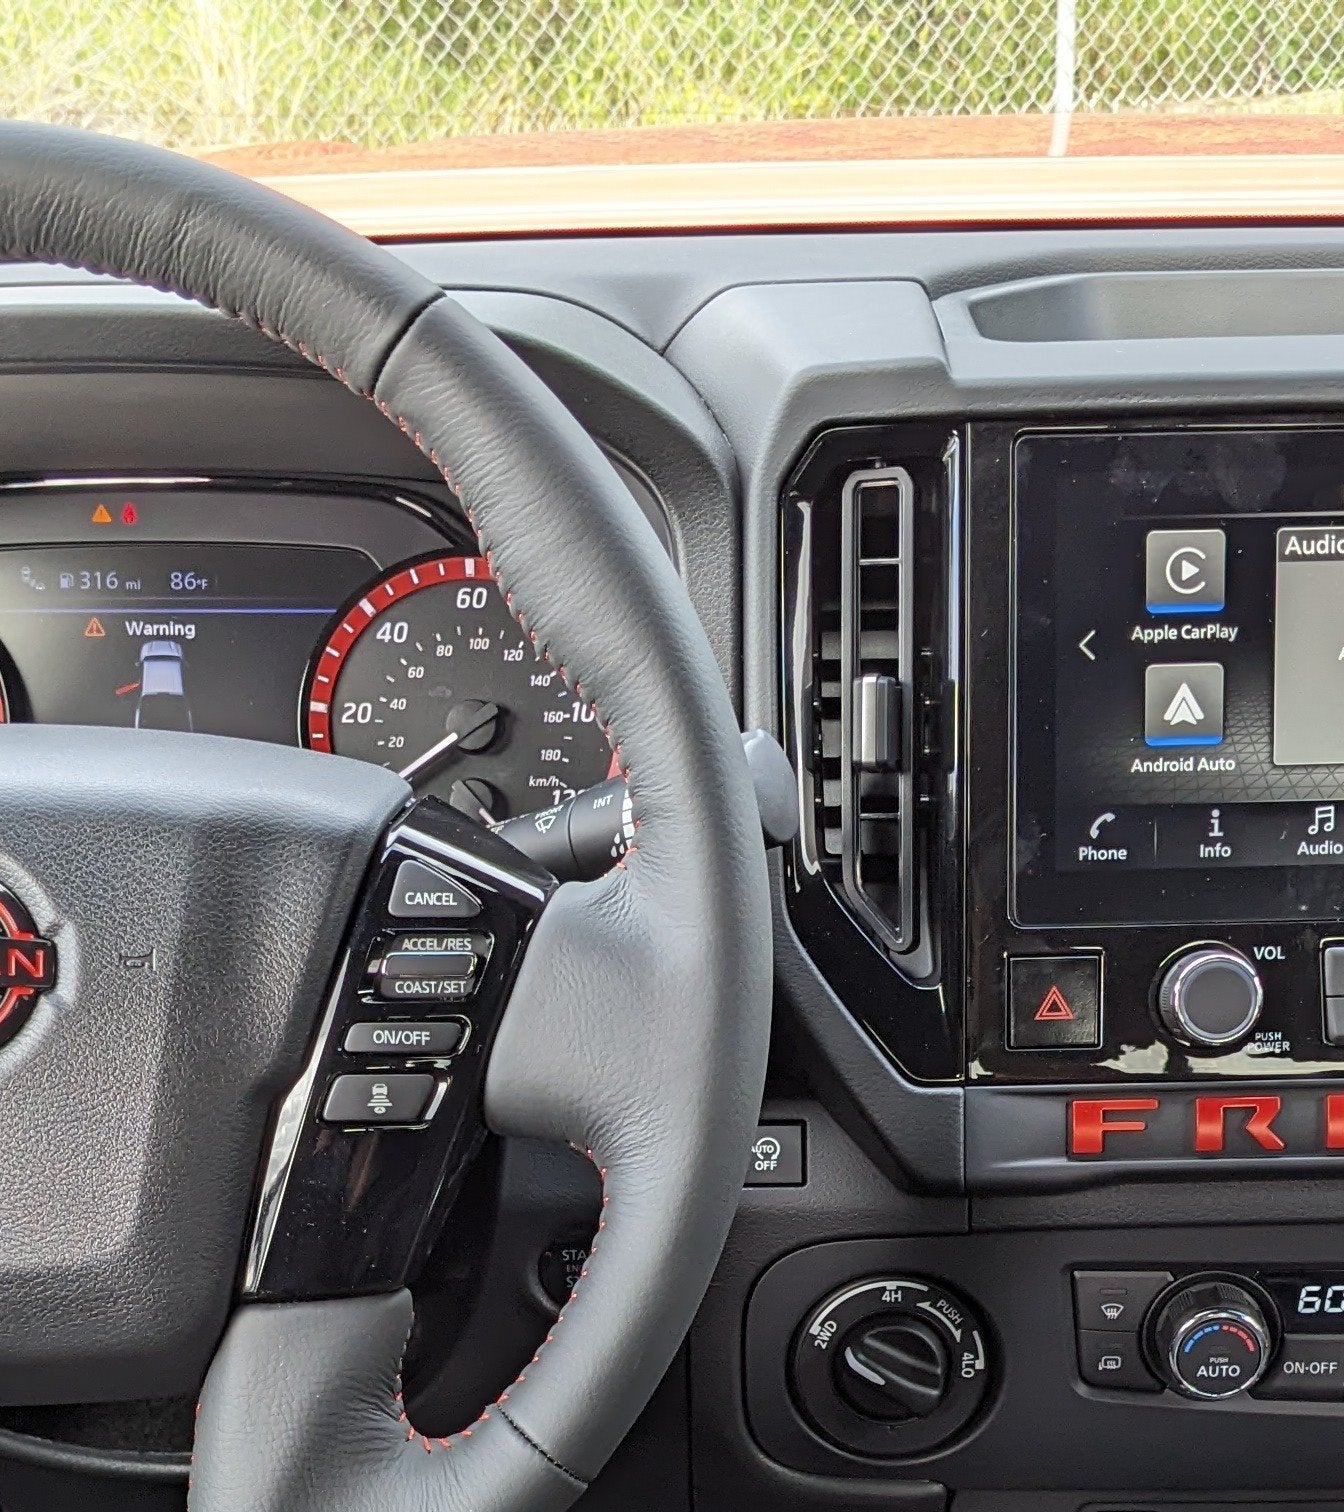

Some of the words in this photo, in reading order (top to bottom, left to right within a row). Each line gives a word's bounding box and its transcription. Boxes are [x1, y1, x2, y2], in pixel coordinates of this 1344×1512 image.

[80, 571, 119, 590] 316
[456, 587, 488, 609] 60
[125, 620, 196, 640] Warning
[376, 621, 409, 643] 40
[1130, 624, 1178, 643] Apple
[1181, 624, 1239, 643] CarPlay
[436, 645, 454, 657] 80
[469, 638, 490, 650] 100
[503, 650, 524, 662] 120
[407, 667, 425, 679] 60
[530, 674, 551, 687] 140
[389, 698, 407, 711] 40
[341, 702, 373, 724] 20
[543, 711, 564, 723] 160
[387, 736, 405, 748] 20
[540, 749, 562, 762] 180
[1130, 756, 1194, 774] Android
[1196, 756, 1237, 773] Auto
[529, 776, 560, 788] km/h
[593, 794, 614, 810] INT
[1078, 844, 1128, 862] Phone
[1199, 842, 1232, 859] Info
[1297, 840, 1344, 857] Audio
[404, 891, 458, 907] CANCEL
[401, 937, 473, 952] ACCEL/RES
[1253, 945, 1287, 961] VOL
[394, 980, 467, 995] COAST/SET
[372, 1030, 431, 1047] ON/OFF
[1254, 1031, 1283, 1041] PUSH
[754, 1160, 778, 1171] OFF
[881, 1290, 903, 1303] 4H
[936, 1299, 964, 1325] PUSH
[814, 1319, 837, 1350] 2WD
[961, 1351, 975, 1378] 4LO
[1196, 1364, 1241, 1378] AUTO
